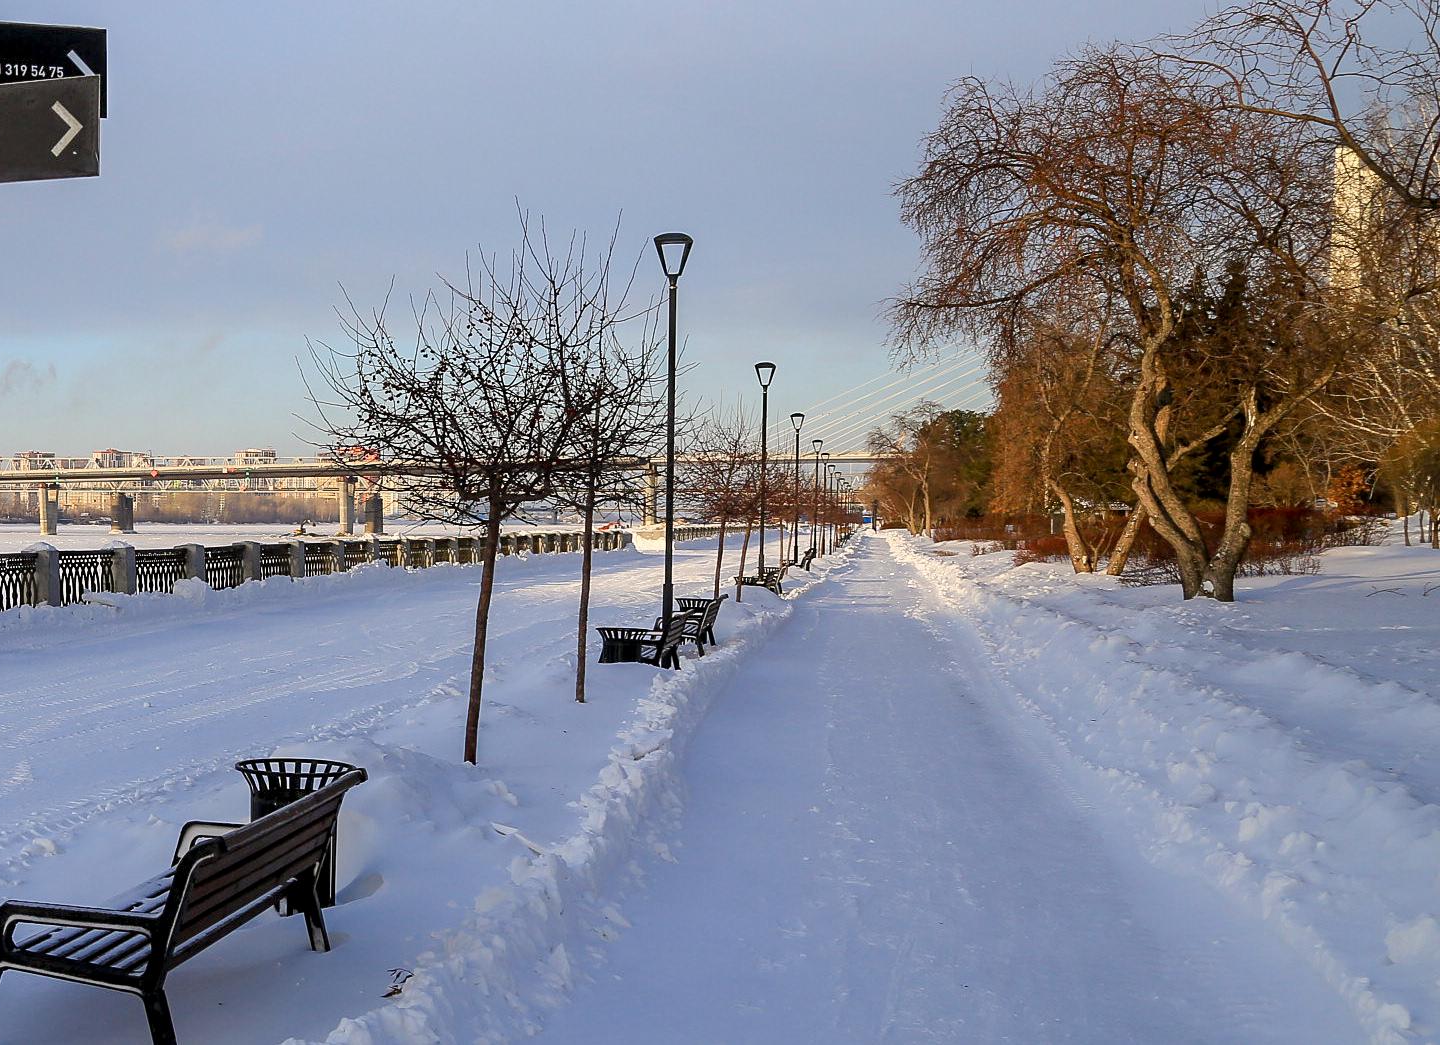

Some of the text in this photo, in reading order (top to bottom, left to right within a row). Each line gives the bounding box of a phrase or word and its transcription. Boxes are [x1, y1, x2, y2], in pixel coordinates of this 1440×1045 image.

[5, 64, 28, 77] 319
[31, 65, 46, 78] 54
[49, 66, 64, 78] 75
